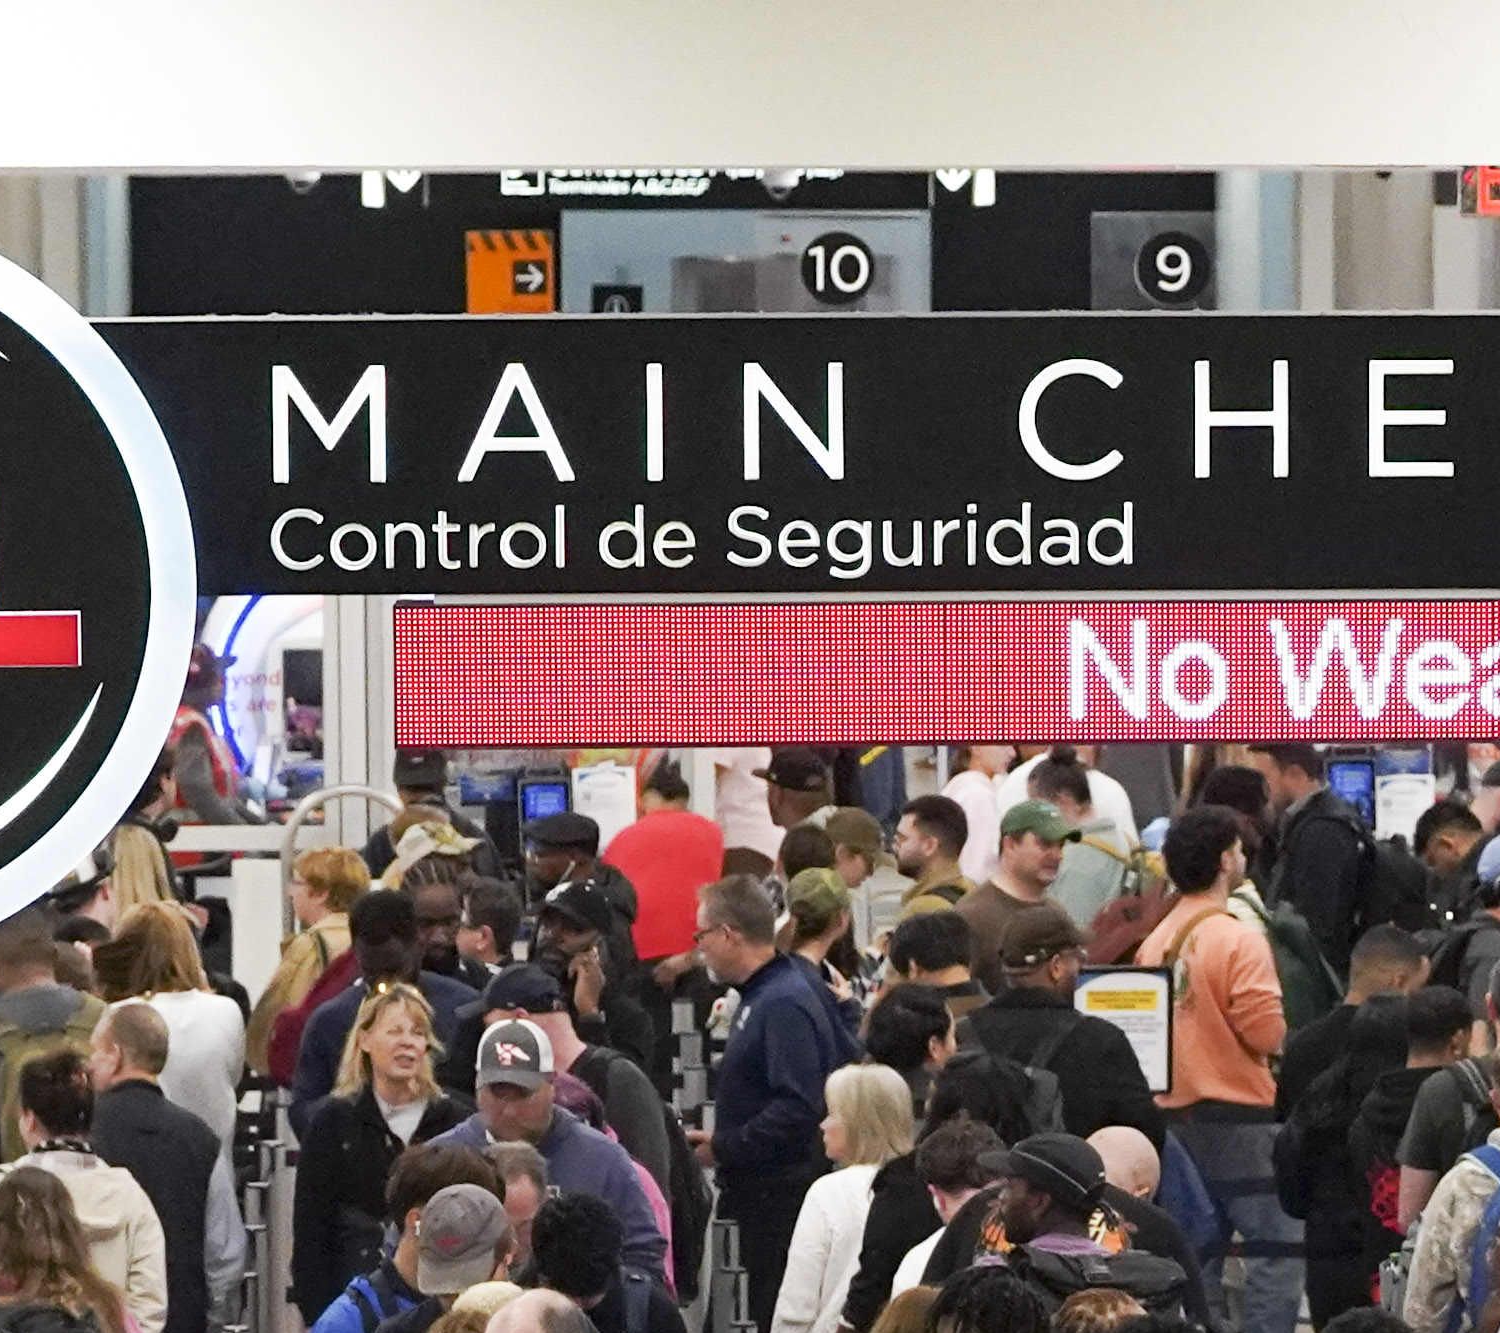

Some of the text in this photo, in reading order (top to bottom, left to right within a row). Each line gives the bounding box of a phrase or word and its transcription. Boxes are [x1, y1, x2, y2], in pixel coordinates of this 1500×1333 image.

[806, 246, 870, 293] 10
[1154, 246, 1192, 293] 9
[272, 361, 845, 484] MAIN
[271, 501, 1134, 579] Control de Seguridad
[1070, 620, 1228, 720] No
